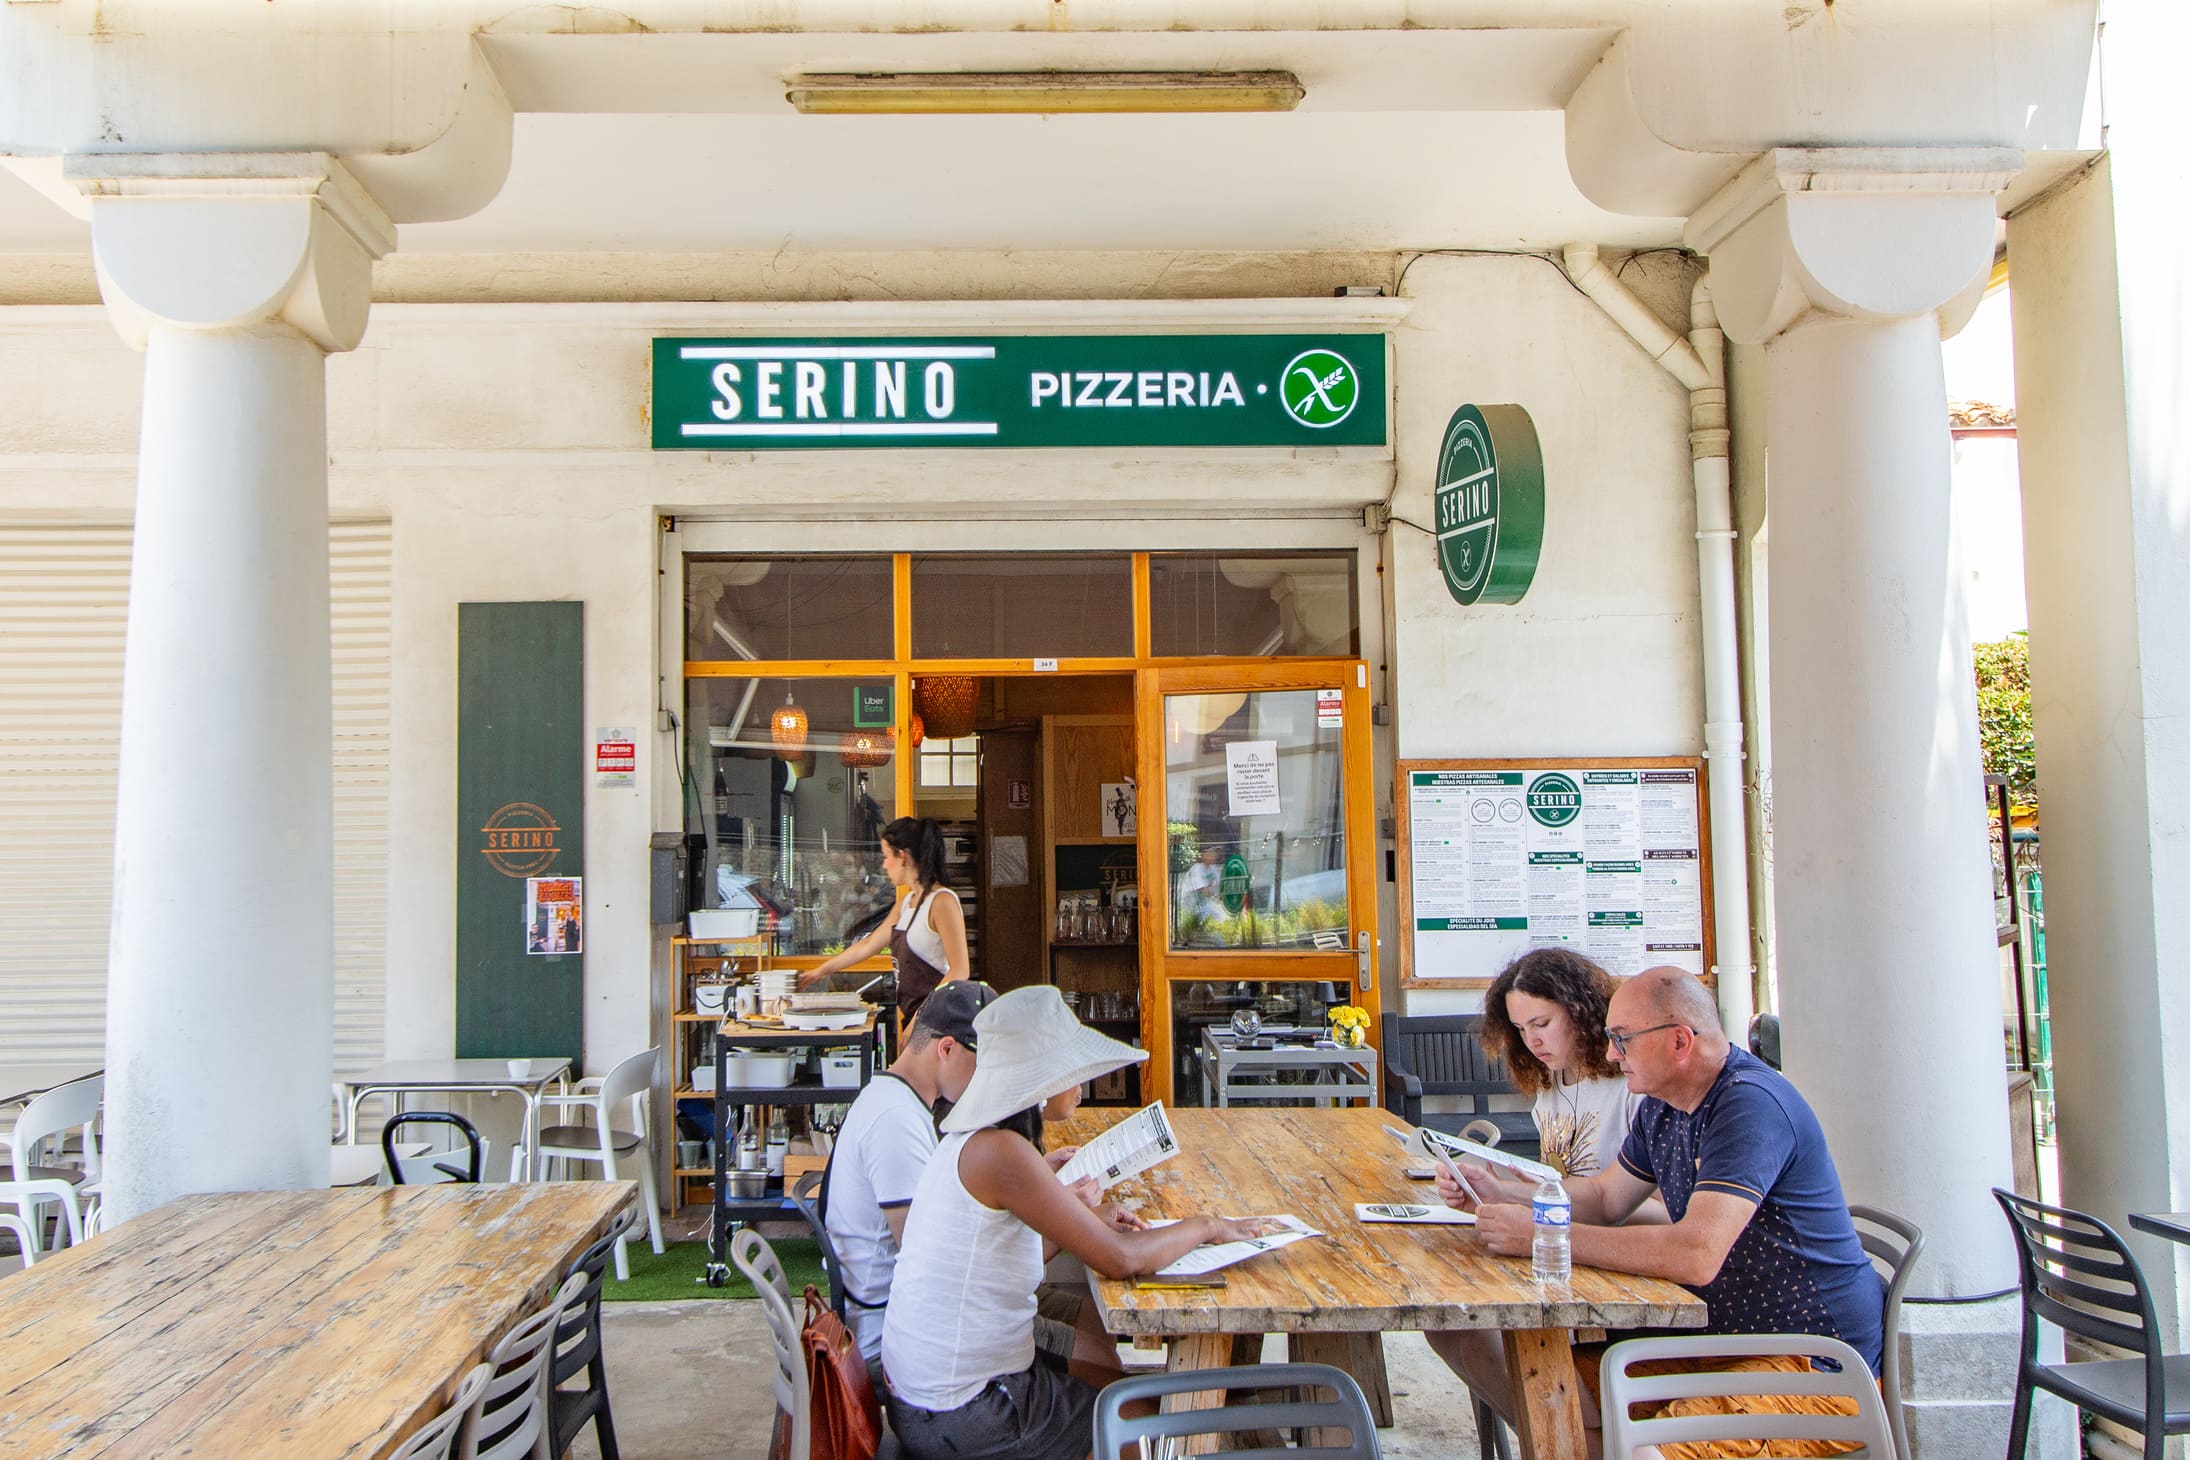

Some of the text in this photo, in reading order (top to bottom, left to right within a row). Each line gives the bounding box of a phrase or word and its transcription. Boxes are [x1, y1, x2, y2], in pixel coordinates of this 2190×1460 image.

[711, 361, 955, 420] SERINO
[1030, 371, 1246, 407] PIZZERIA
[1453, 437, 1473, 456] PIZZERIA
[1442, 480, 1489, 528] SERINO
[863, 697, 884, 705] Uber
[864, 704, 884, 713] Eats
[600, 744, 632, 753] Alarme
[1533, 794, 1575, 806] SERINO
[488, 831, 554, 848] SERINO
